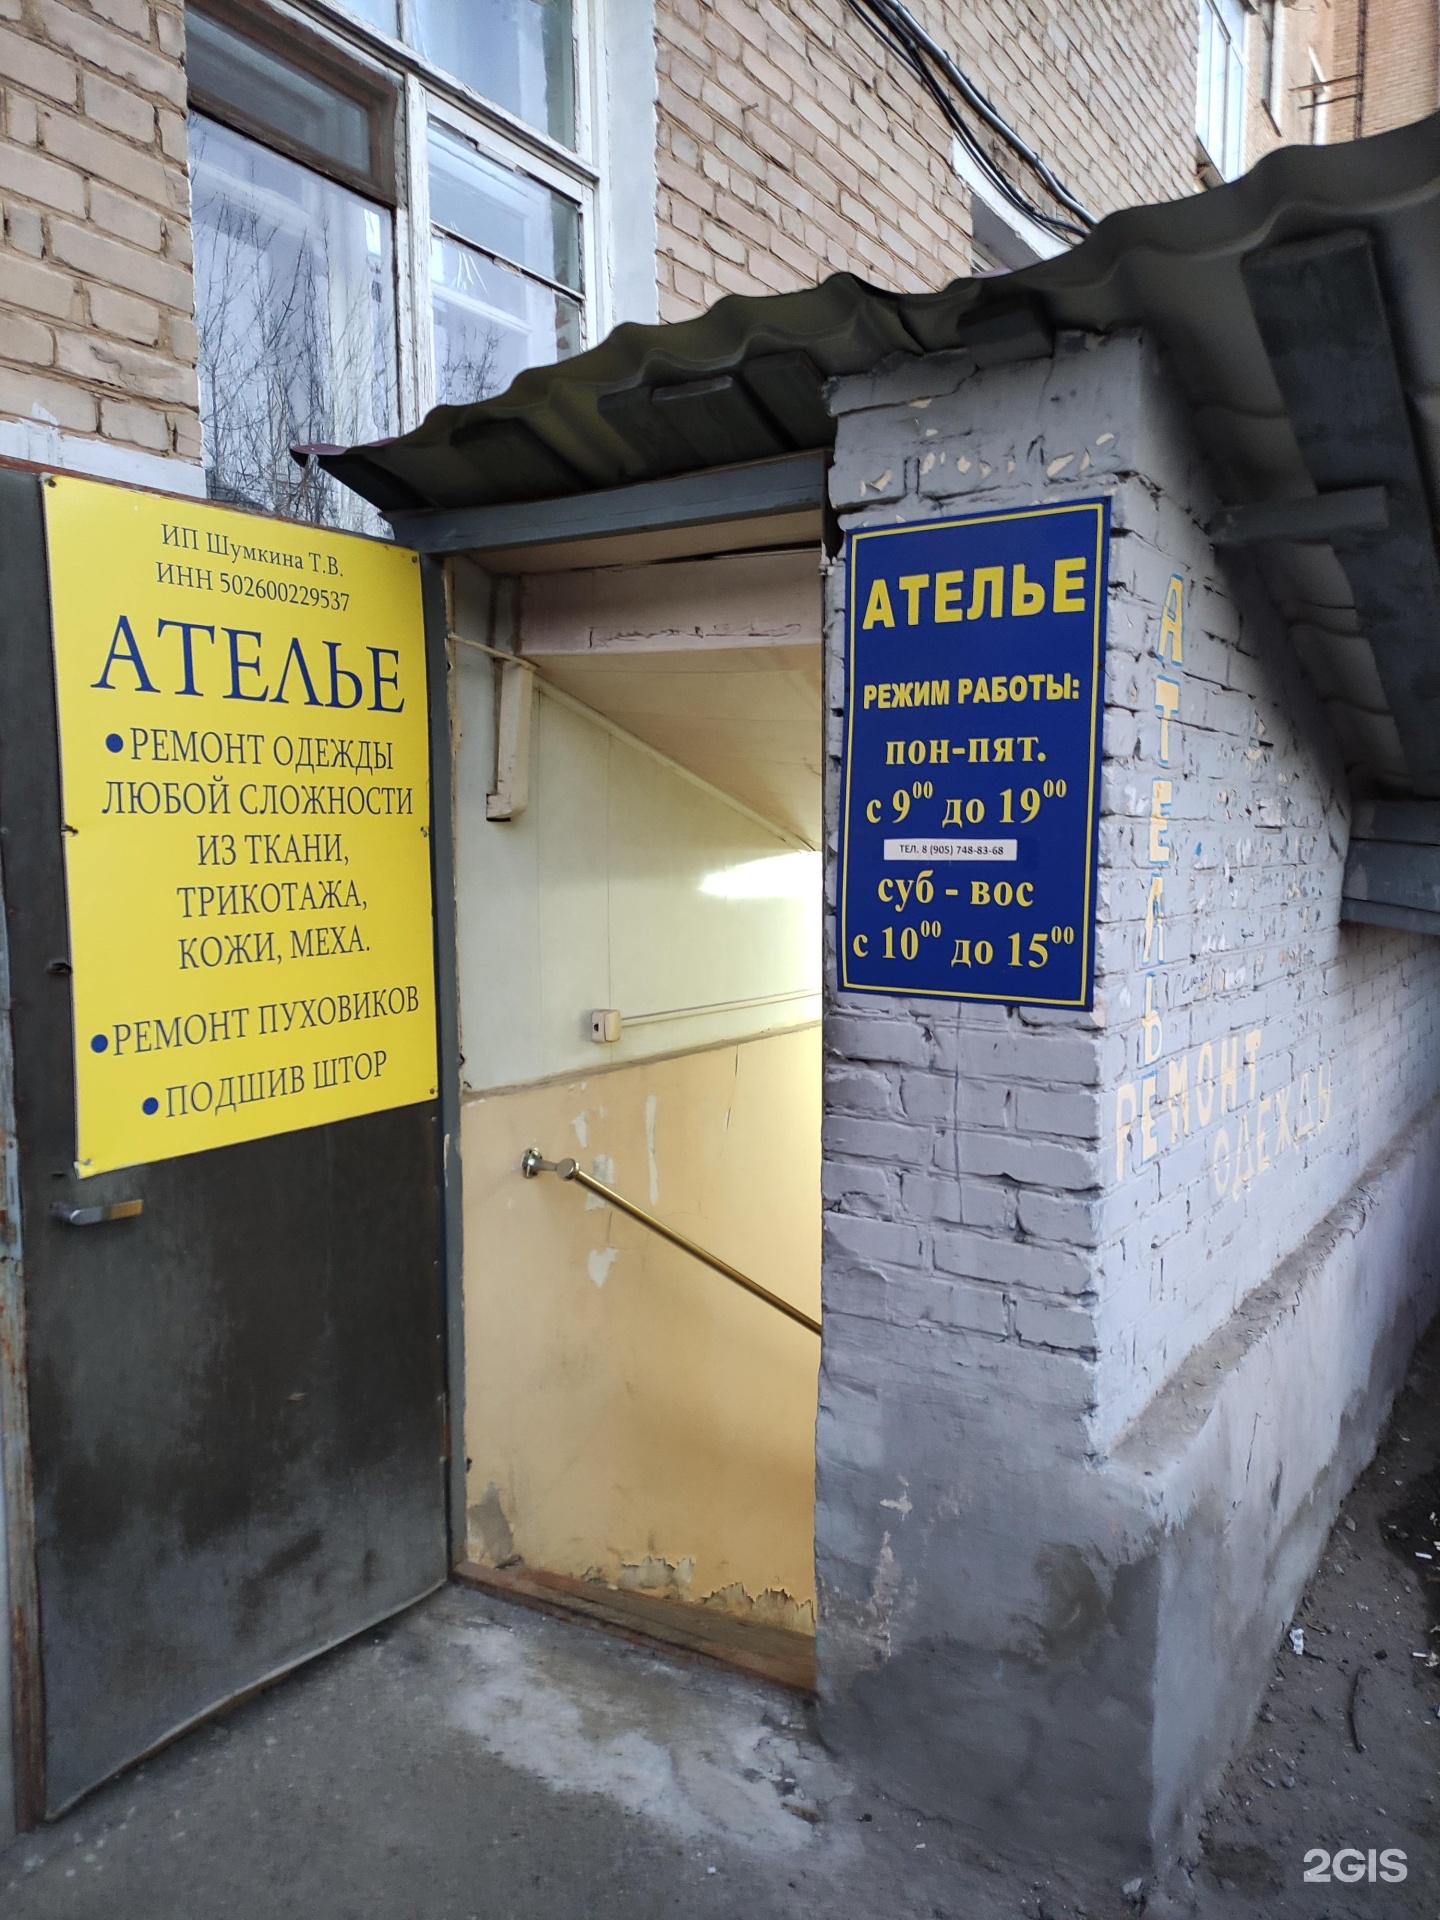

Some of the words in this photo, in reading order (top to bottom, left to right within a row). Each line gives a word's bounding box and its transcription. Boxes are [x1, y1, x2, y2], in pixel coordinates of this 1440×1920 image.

[161, 524, 199, 550] ИП
[206, 532, 304, 570] Шумкина
[309, 553, 344, 577] Т.В.
[156, 562, 213, 591] ИНН
[220, 573, 350, 611] 502600229537
[862, 557, 1086, 630] АТЕЛЬЕ
[90, 615, 405, 713] АТЕЛЬЕ
[863, 679, 950, 709] РЕЖИМ
[957, 672, 1080, 704] РАБОТЫ:
[130, 727, 265, 765] РЕМОНТ
[274, 736, 394, 774] ОДЕЖДЫ
[101, 775, 230, 814] ЛЮБОЙ
[239, 784, 413, 815] СЛОЖНОСТИ
[941, 798, 986, 829] до
[197, 834, 237, 866] ИЗ
[245, 833, 350, 866] ТКАНИ,
[899, 844, 919, 854] ТЕЛ.
[921, 845, 928, 854] 8
[929, 845, 954, 856] (905)
[956, 845, 1004, 855] 748-83-68
[177, 879, 368, 918] ТРИКОТАЖА,
[877, 869, 935, 913] суб
[970, 880, 1034, 907] вос
[178, 932, 283, 969] КОЖИ,
[290, 924, 370, 959] МЕХА.
[951, 939, 993, 969] до
[113, 1007, 249, 1056] РЕМОНТ
[258, 984, 420, 1034] ПУХОВИКОВ
[165, 1065, 305, 1118] ПОДШИВ
[312, 1049, 387, 1090] ШТОР
[1115, 1029, 1261, 1181] РЕМОНТ
